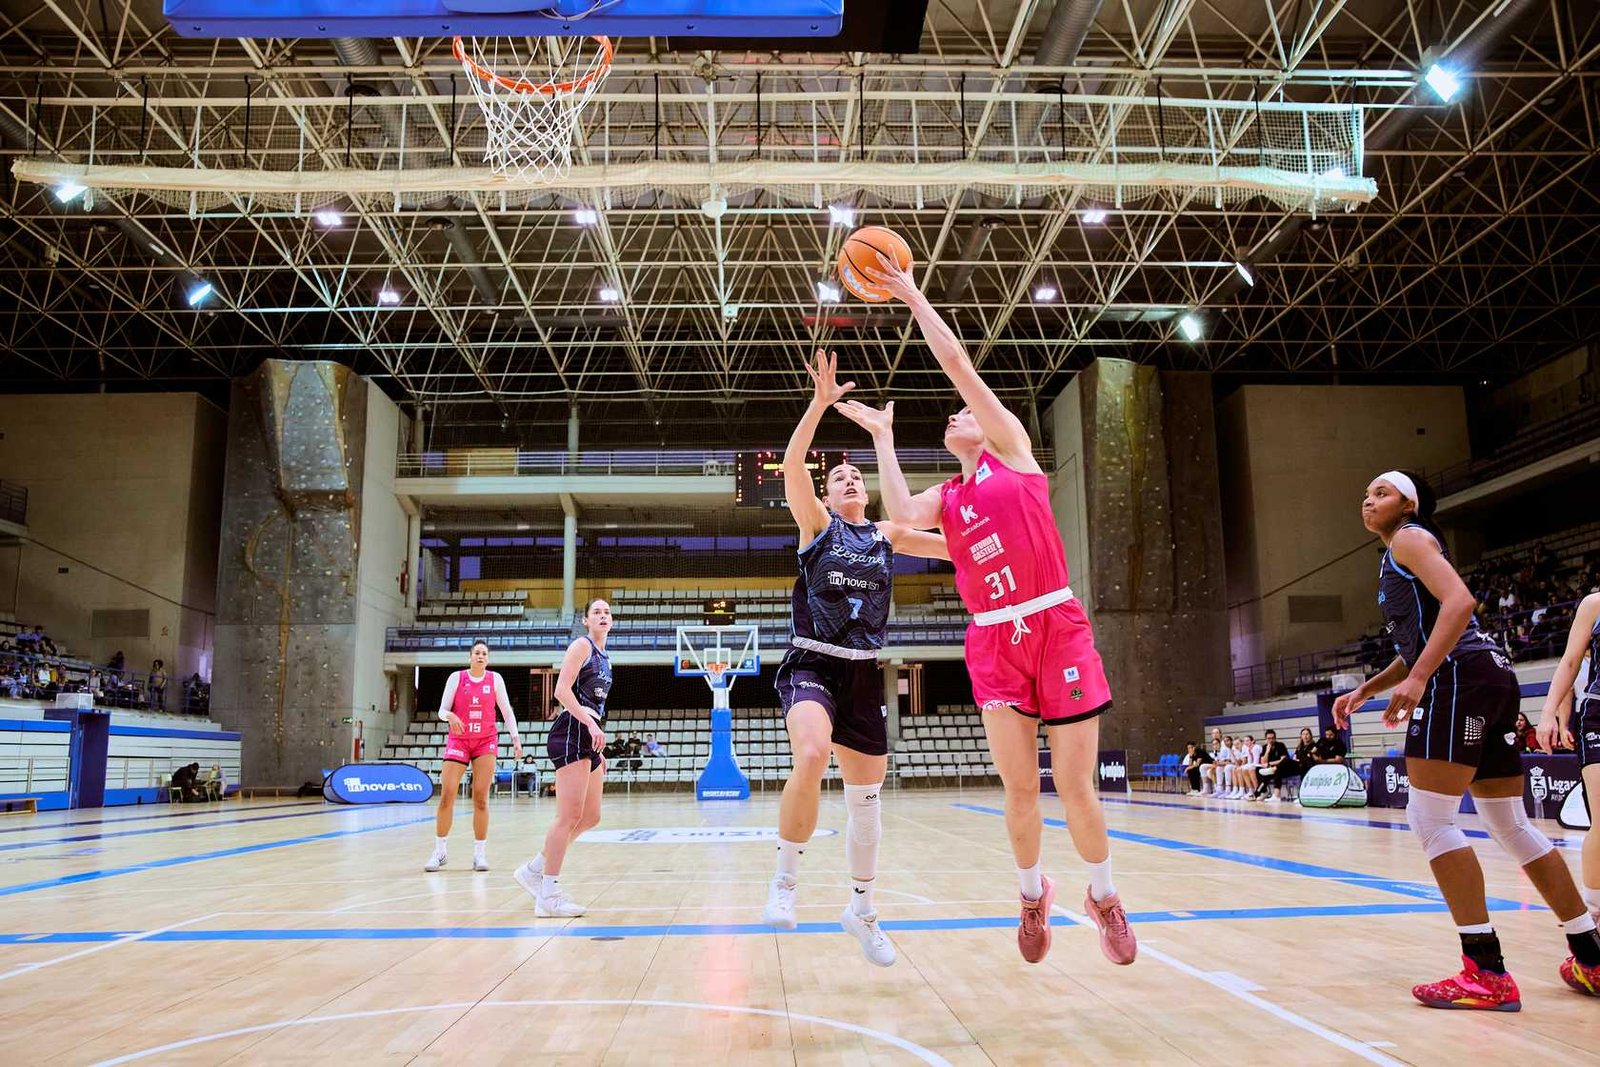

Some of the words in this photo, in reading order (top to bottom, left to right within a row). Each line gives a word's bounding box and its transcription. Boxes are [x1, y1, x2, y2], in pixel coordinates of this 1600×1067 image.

[984, 565, 1017, 600] 31
[848, 598, 863, 619] 7
[468, 723, 481, 733] 15
